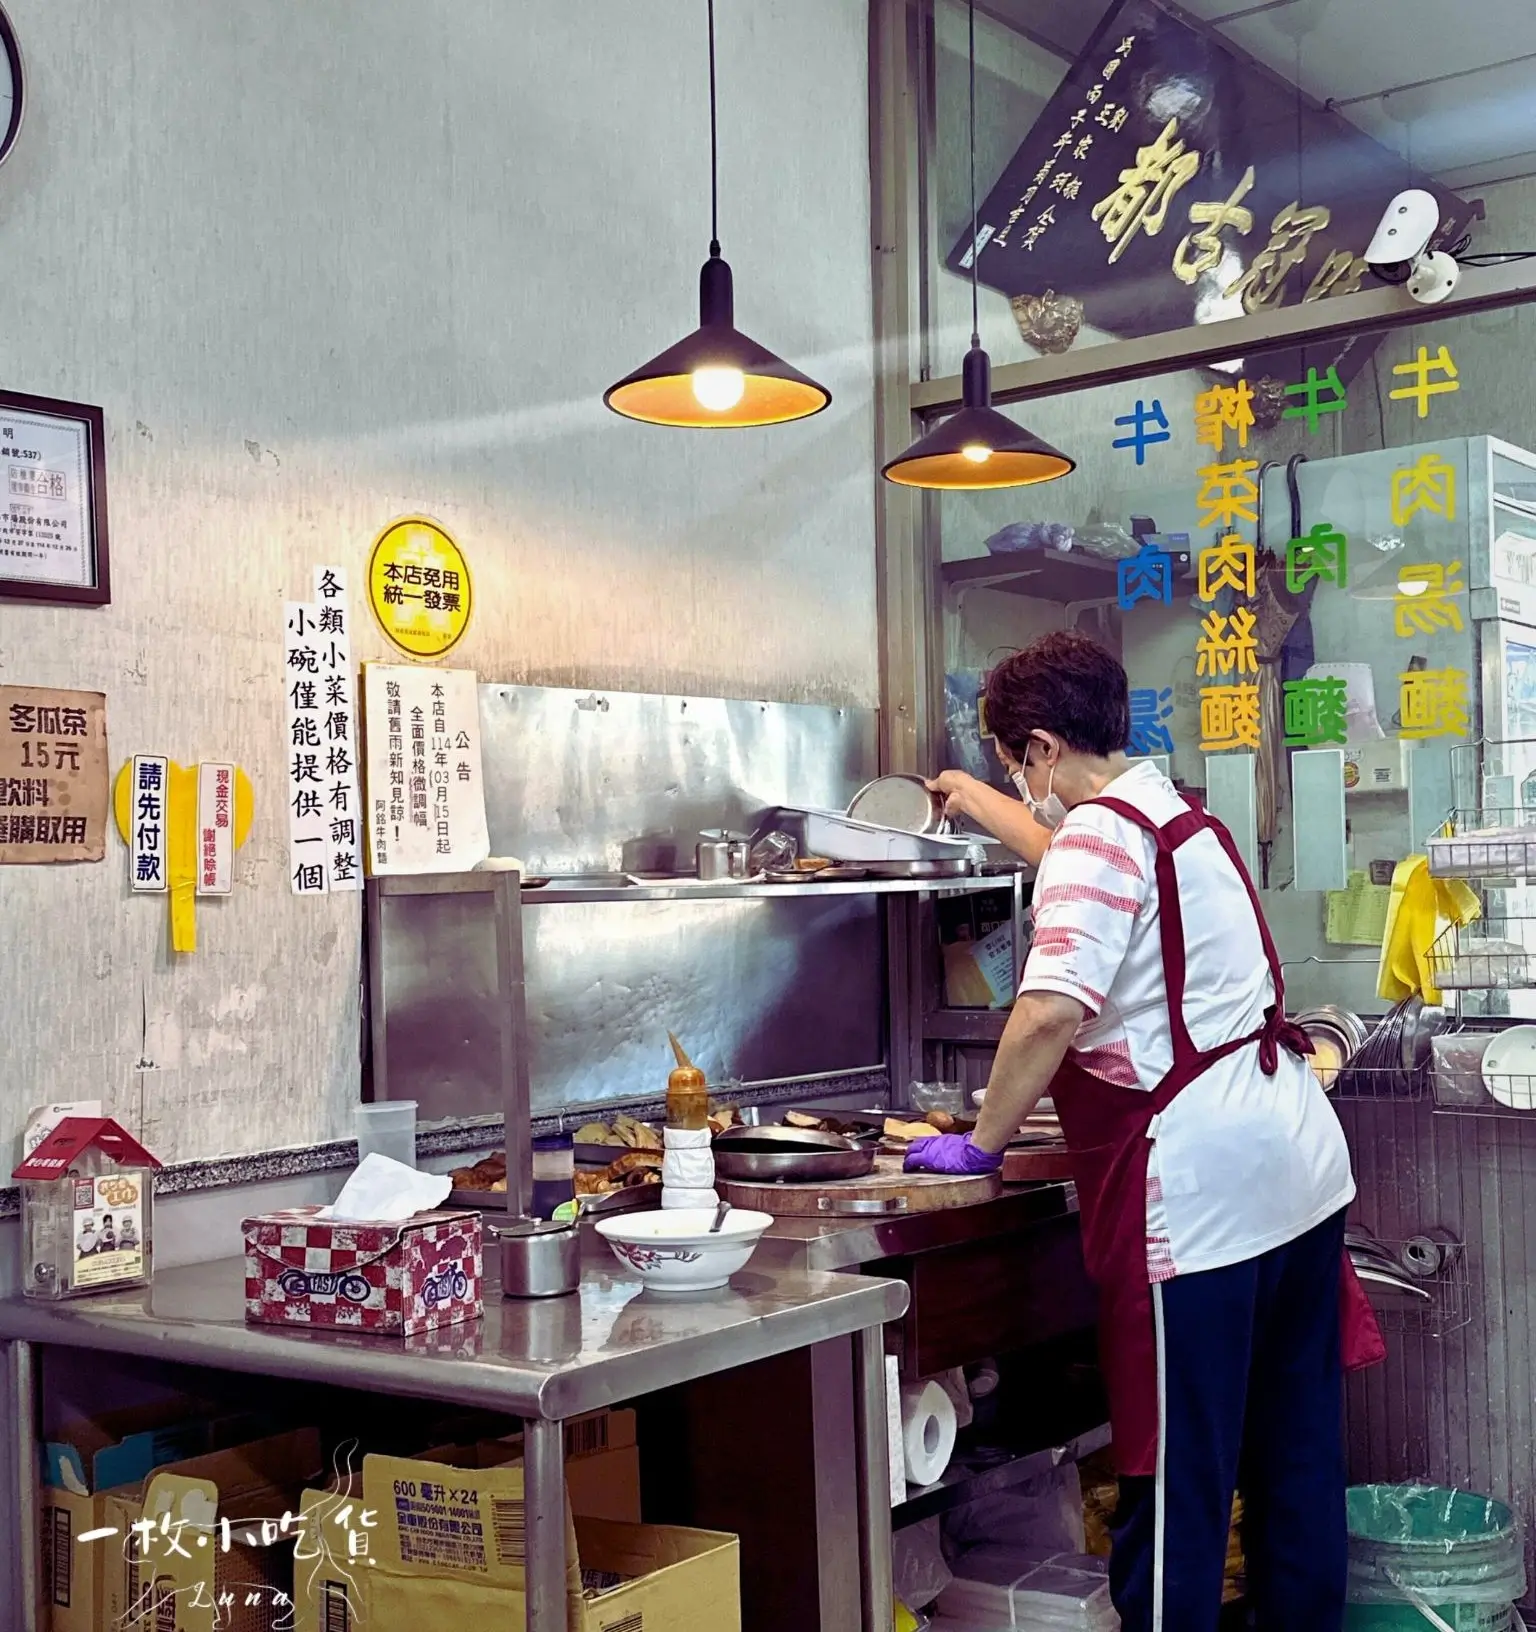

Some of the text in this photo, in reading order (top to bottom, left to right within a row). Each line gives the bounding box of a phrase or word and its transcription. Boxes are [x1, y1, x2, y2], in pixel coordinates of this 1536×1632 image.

[0, 512, 68, 529] 市場股份有限公司
[383, 561, 460, 591] 本店免用
[383, 583, 462, 613] 統一發票
[9, 703, 88, 737] 冬瓜茶
[318, 569, 359, 882] 各類小菜價格有調整
[21, 740, 81, 771] 15元
[286, 607, 325, 892] 小碗僅能提供一個
[215, 769, 230, 828] 現金交易
[137, 762, 163, 882] 請先付款
[203, 828, 217, 886] 謝絕賒帳
[393, 1479, 417, 1497] 600
